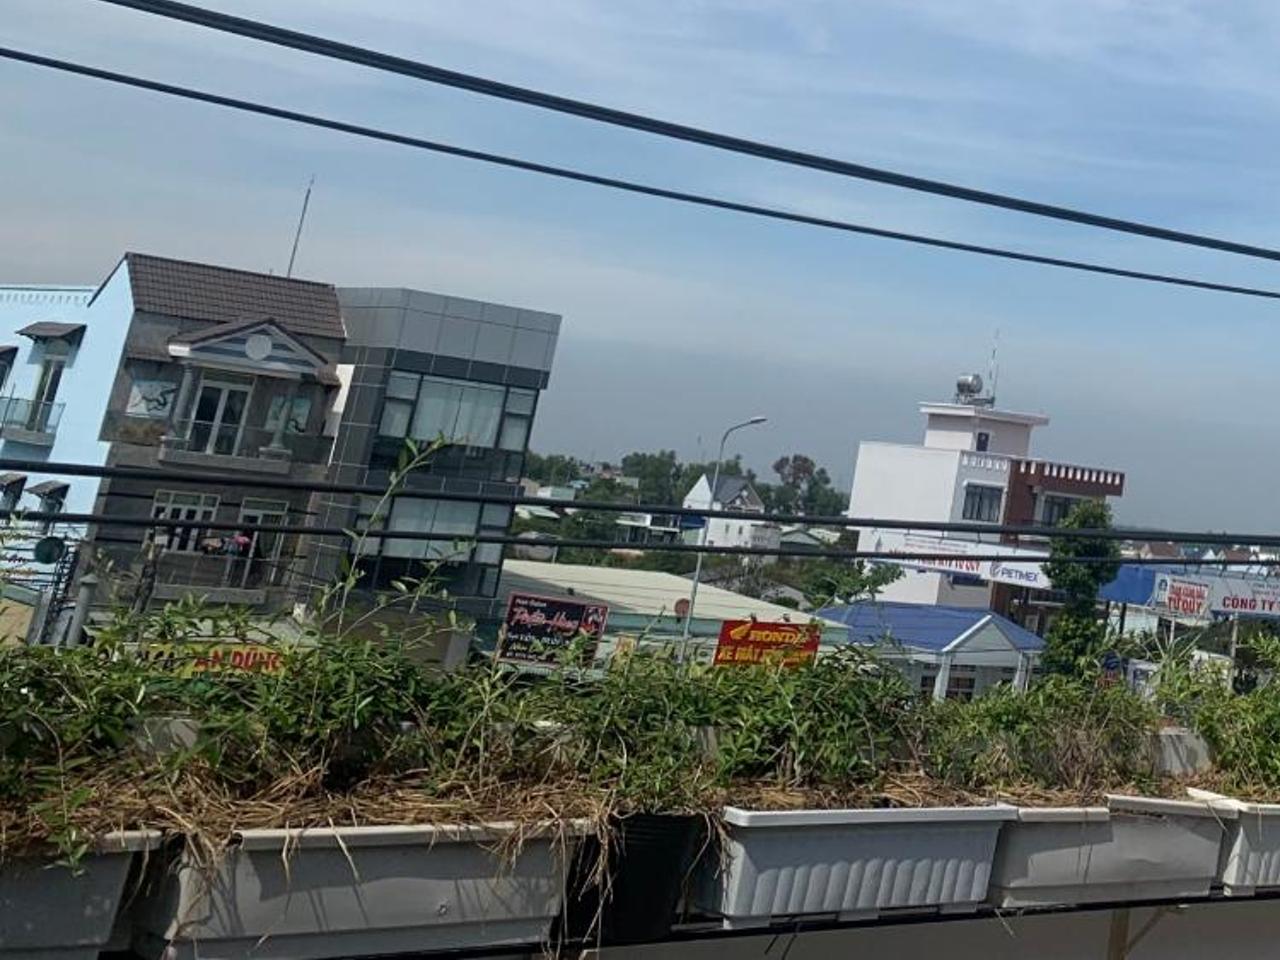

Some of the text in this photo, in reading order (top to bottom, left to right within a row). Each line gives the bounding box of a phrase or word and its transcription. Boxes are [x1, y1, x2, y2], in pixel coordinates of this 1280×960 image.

[1001, 567, 1039, 582] PETIMEX
[1222, 594, 1257, 611] CÔNG
[1261, 598, 1274, 612] TY
